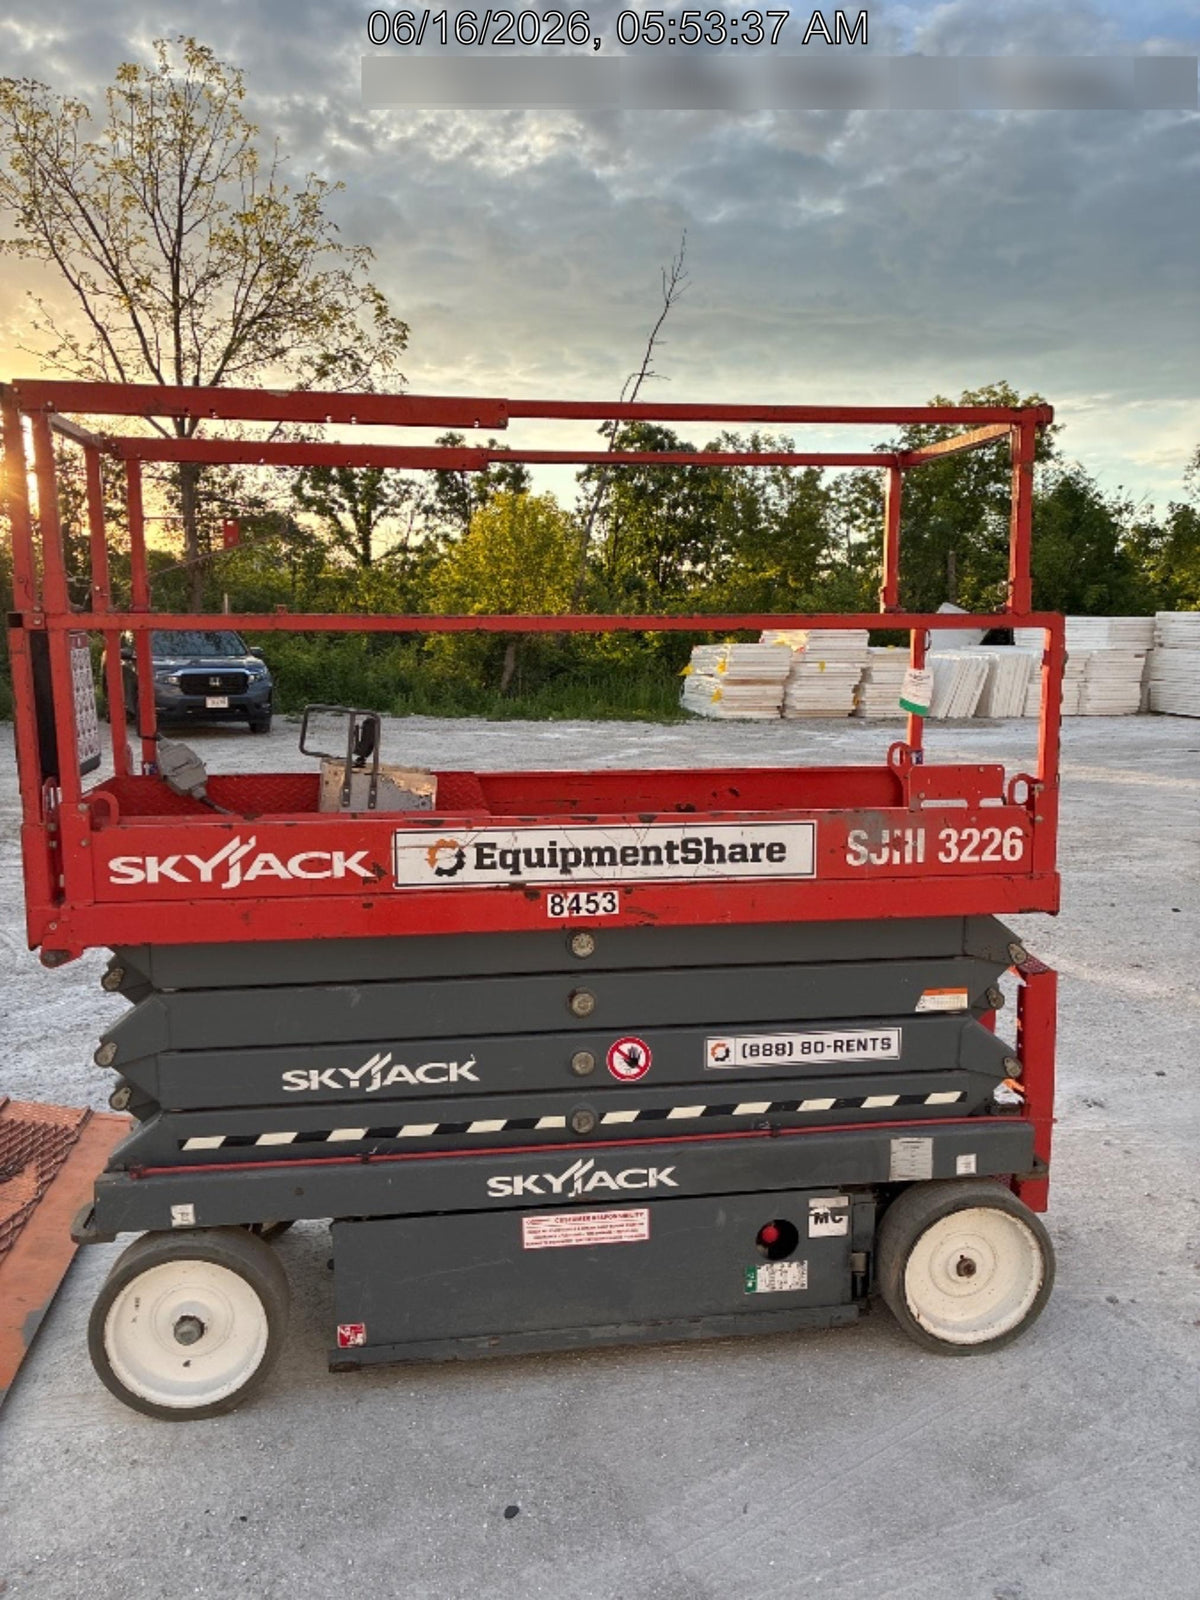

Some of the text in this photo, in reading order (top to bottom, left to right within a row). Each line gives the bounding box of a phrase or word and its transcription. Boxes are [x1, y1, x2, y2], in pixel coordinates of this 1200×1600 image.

[108, 836, 374, 889] SKYJACK
[474, 836, 786, 876] EquipmentShare
[938, 826, 1024, 863] 3226
[550, 892, 616, 916] 8453
[742, 1037, 892, 1059] (888) 80-RENTS
[282, 1052, 480, 1092] SKYJACK
[486, 1158, 679, 1197] SKYJACK
